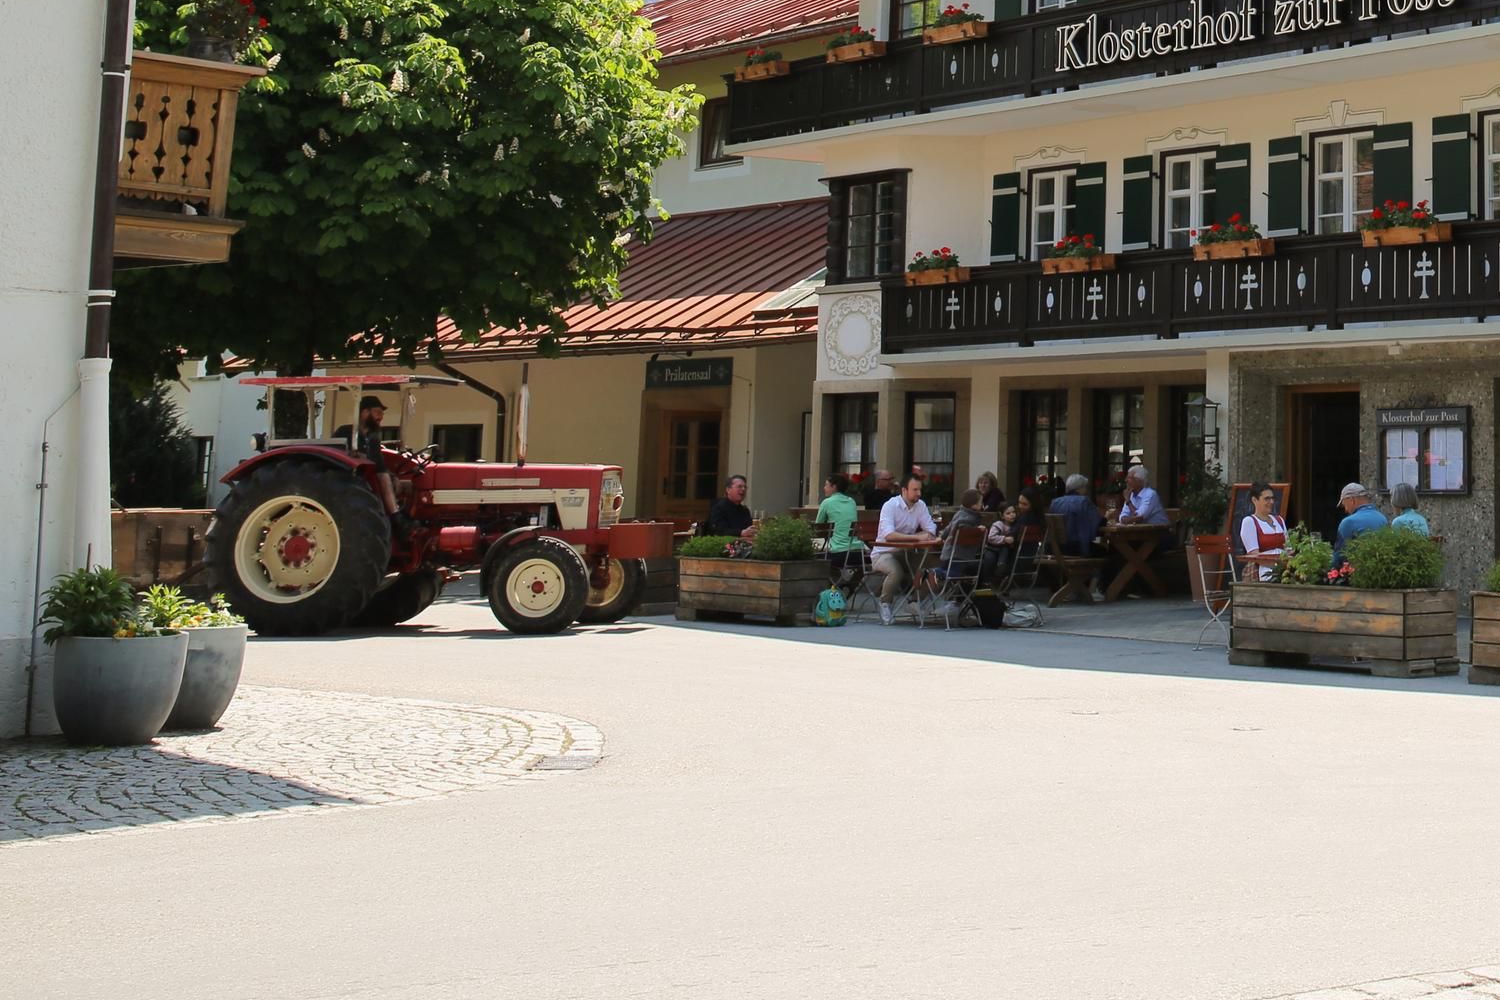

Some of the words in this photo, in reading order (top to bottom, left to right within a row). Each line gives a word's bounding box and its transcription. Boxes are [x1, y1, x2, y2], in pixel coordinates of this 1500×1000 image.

[664, 365, 712, 382] Prälatensaal
[1382, 410, 1425, 423] Klosterhof
[1426, 414, 1439, 422] zur
[1441, 411, 1458, 422] Post
